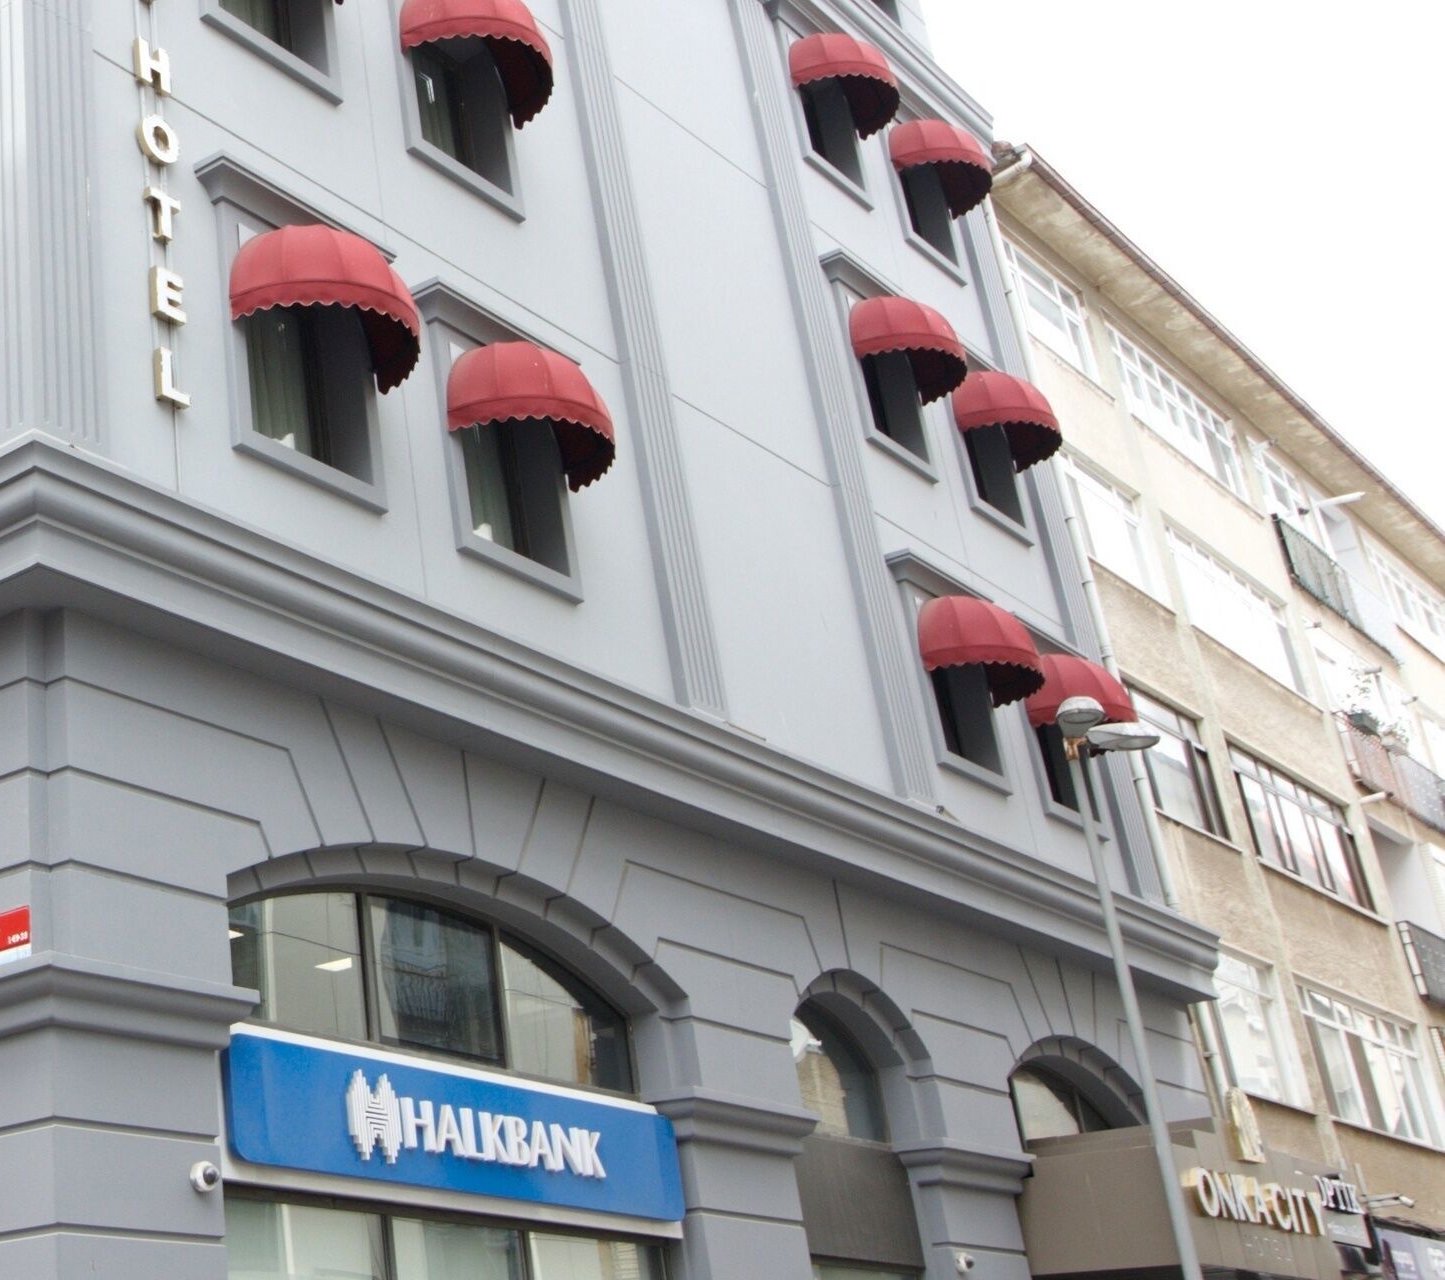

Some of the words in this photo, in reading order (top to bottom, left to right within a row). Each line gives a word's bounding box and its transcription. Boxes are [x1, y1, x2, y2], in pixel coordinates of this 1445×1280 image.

[133, 35, 192, 410] HOTEL
[400, 1096, 607, 1180] HALKBANK
[1194, 1166, 1275, 1226] ONKA
[1268, 1181, 1327, 1237] CITY
